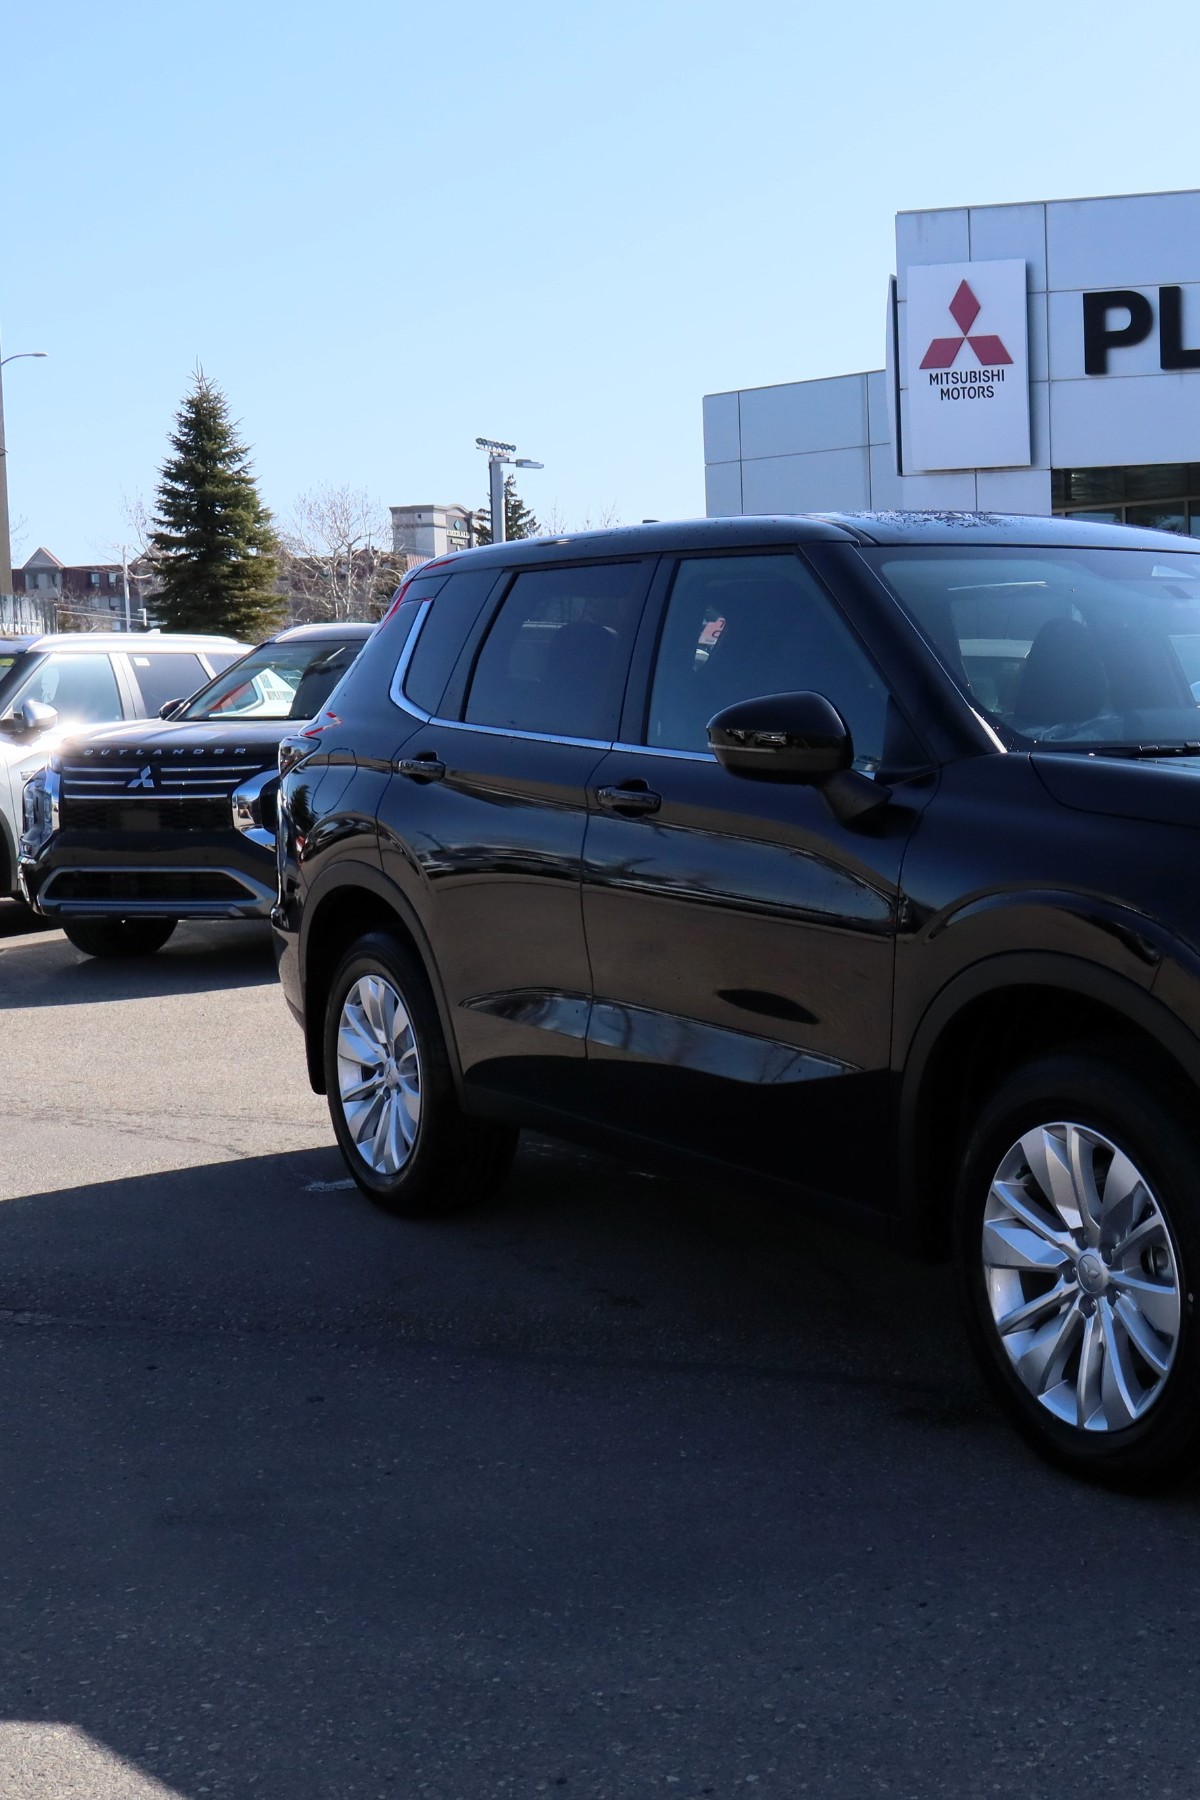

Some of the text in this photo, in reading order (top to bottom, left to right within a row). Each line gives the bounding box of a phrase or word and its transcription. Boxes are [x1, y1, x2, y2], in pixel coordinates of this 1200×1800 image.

[929, 369, 1005, 386] MITSUBISHI
[940, 385, 995, 401] MOTORS
[0, 622, 42, 635] VENTURE
[83, 748, 246, 756] OUTLANDER
